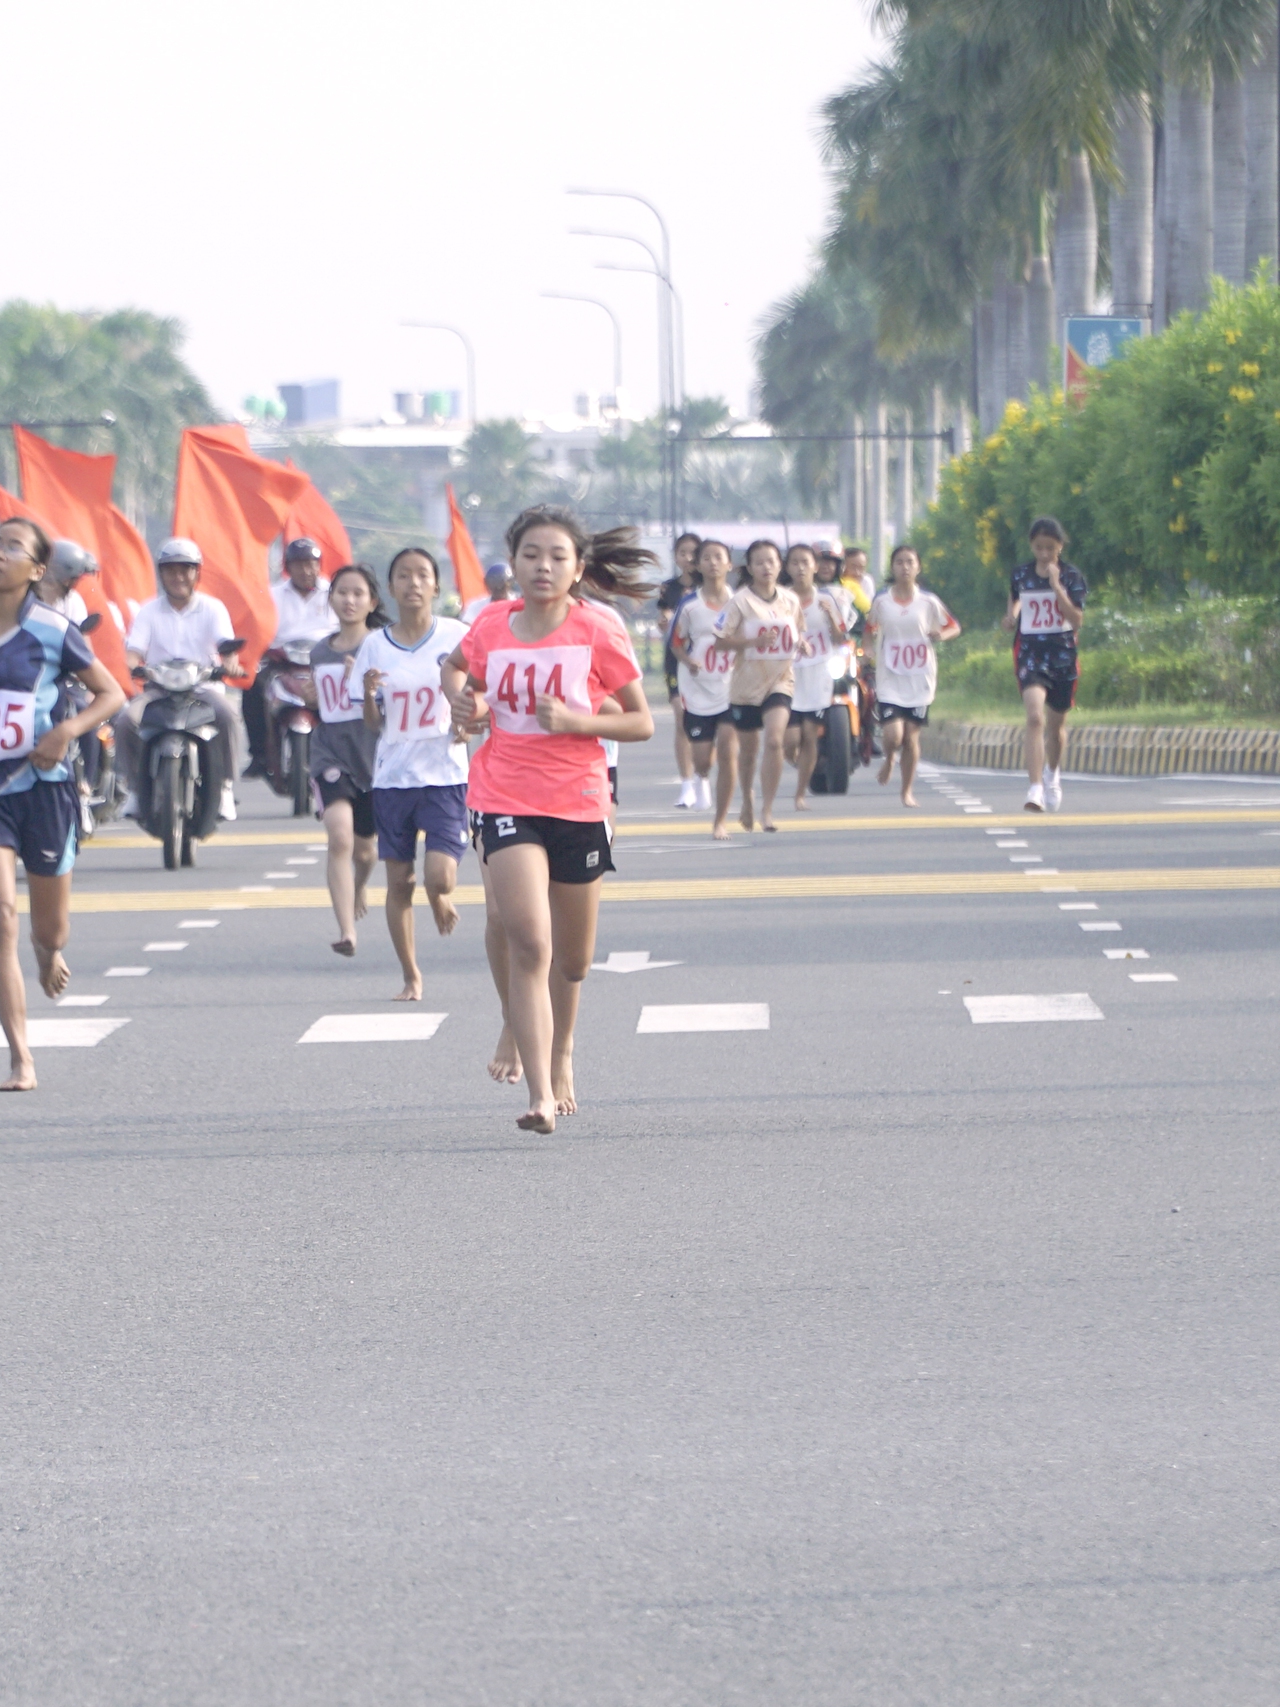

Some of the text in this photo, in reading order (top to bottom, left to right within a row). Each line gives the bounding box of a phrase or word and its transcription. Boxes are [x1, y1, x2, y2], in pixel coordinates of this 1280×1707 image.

[705, 644, 736, 673] 03
[891, 644, 928, 669] 709
[322, 674, 365, 713] 06
[497, 662, 566, 715] 414
[392, 686, 450, 732] 72
